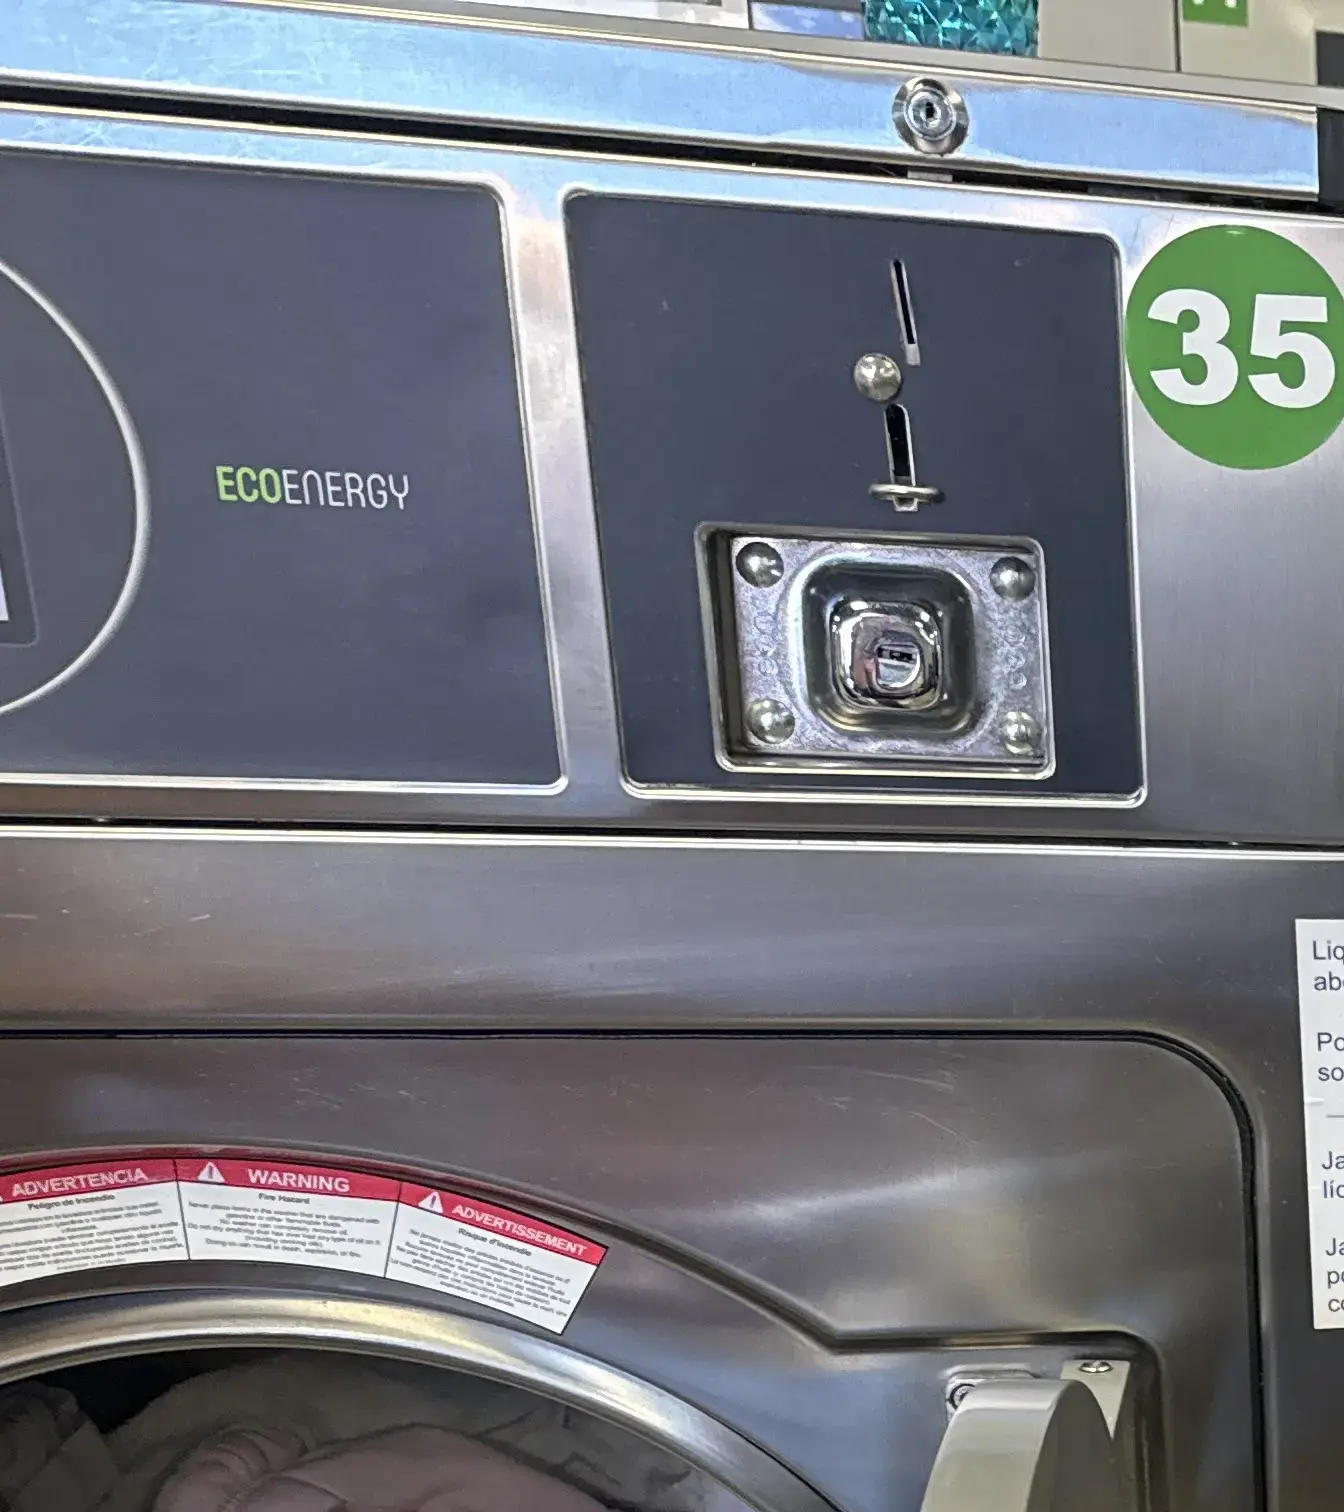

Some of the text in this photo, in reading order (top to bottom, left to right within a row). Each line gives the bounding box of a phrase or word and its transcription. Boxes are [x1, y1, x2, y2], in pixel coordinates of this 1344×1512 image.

[1147, 288, 1336, 408] 35
[215, 465, 409, 510] ECOENERGY
[12, 1168, 150, 1197] ADVERTENCIA
[247, 1168, 350, 1193] WARNING
[452, 1204, 588, 1256] ADVERTISSEMENT
